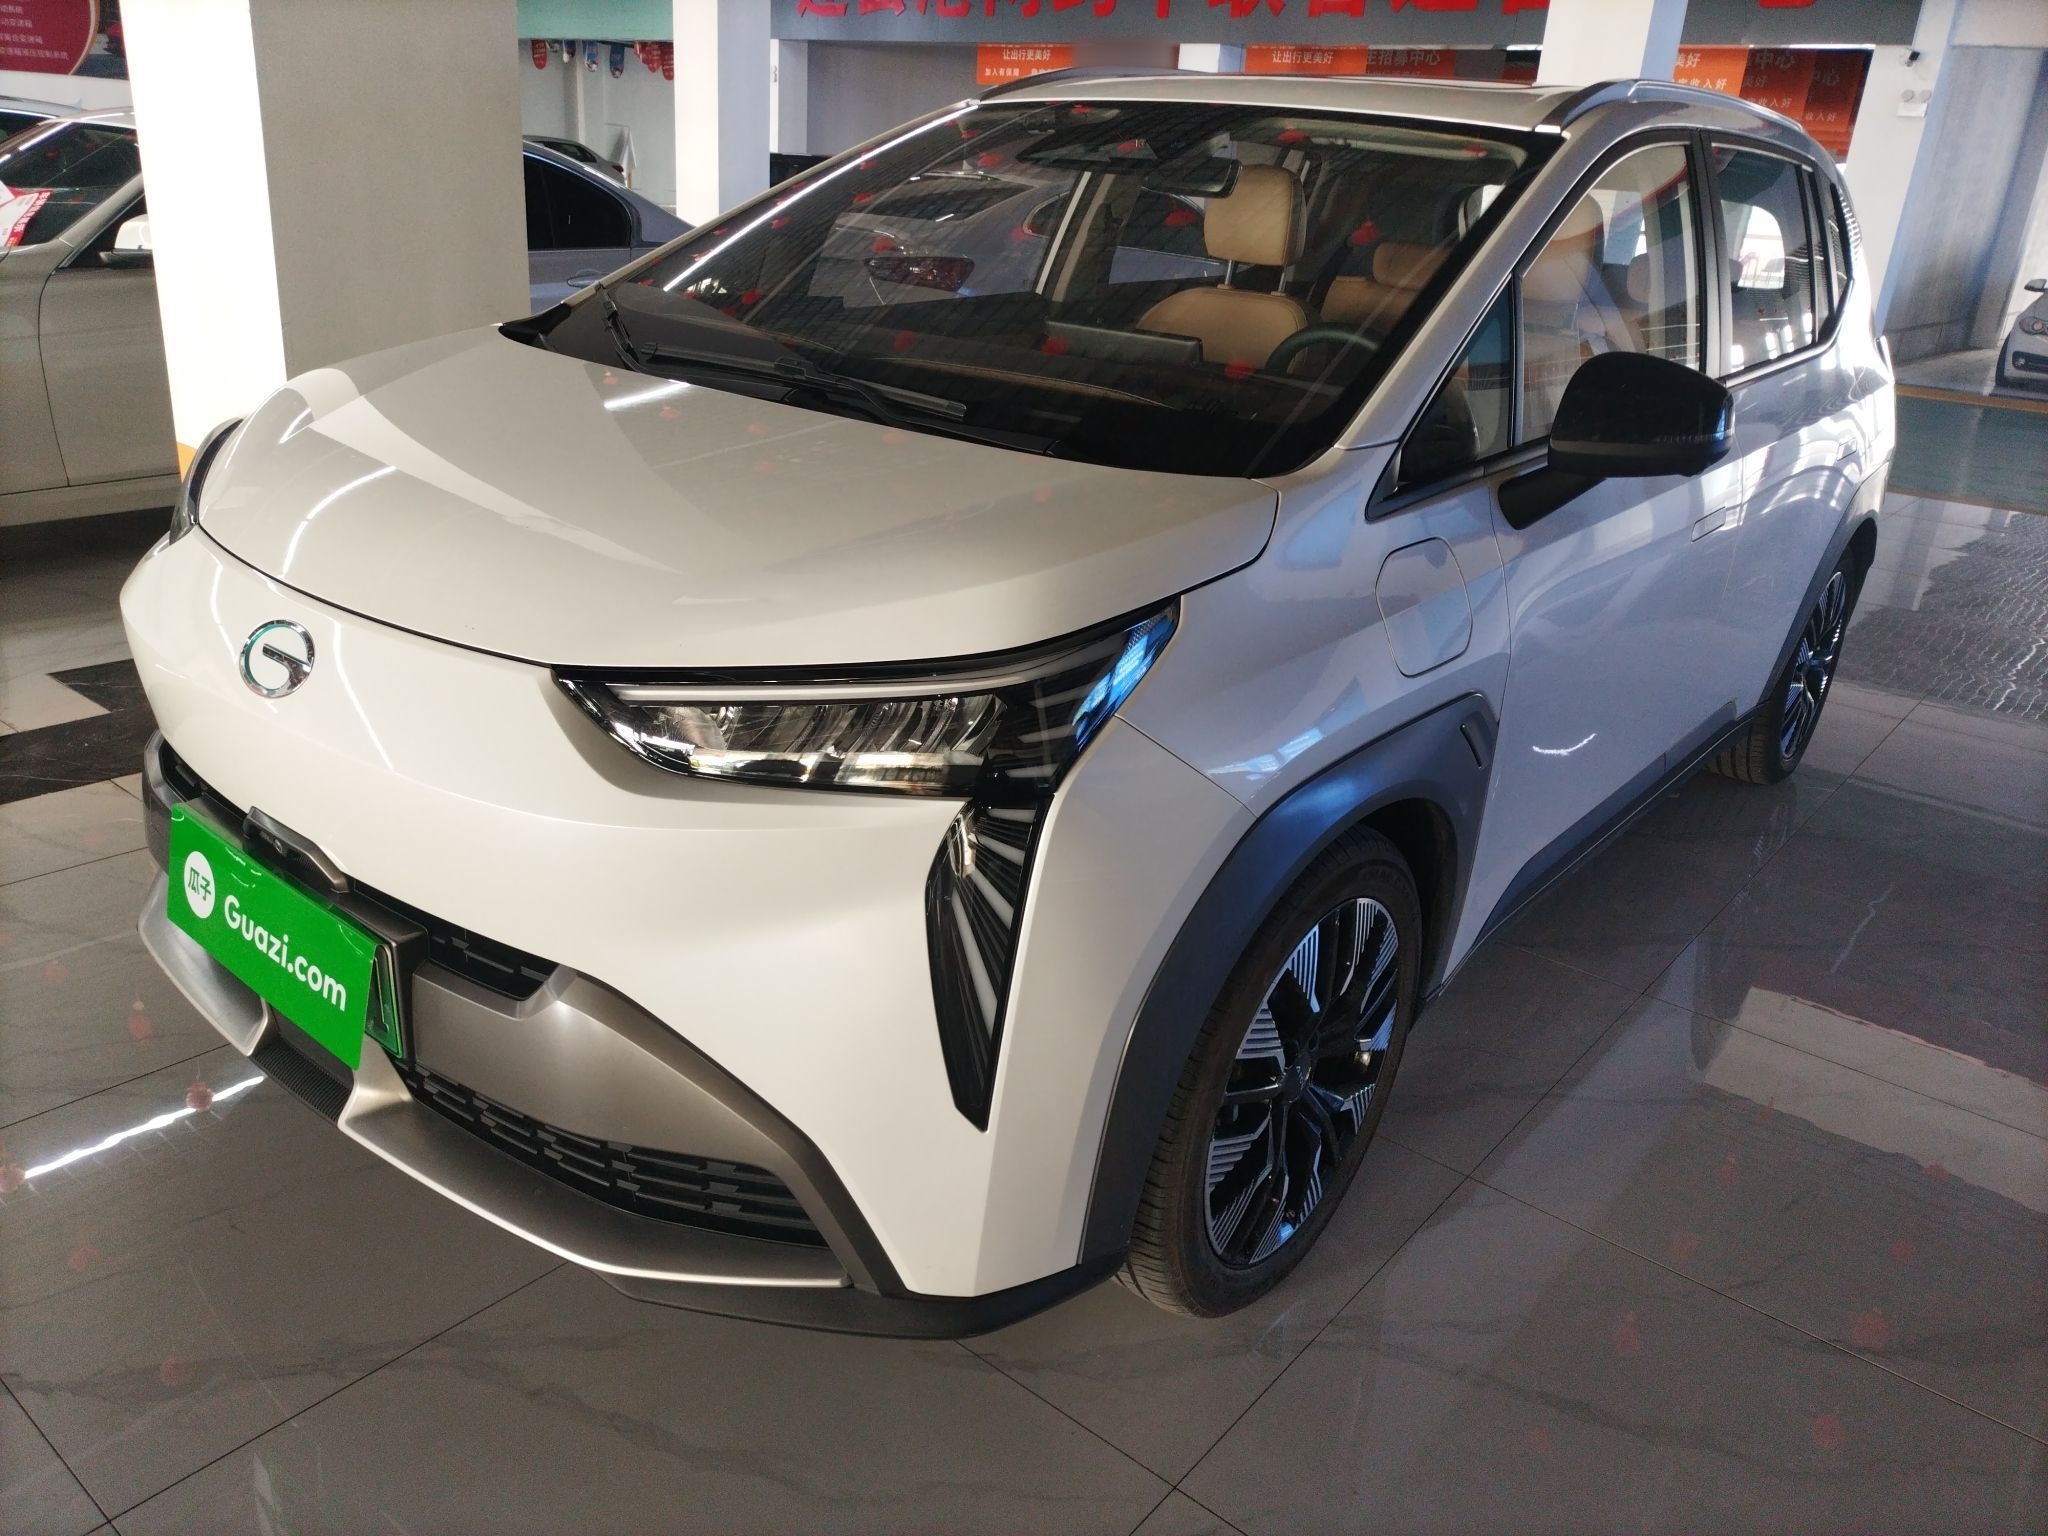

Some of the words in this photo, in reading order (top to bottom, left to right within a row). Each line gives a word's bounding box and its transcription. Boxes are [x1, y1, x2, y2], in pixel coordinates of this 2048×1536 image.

[1003, 48, 1051, 60] 让出行更美好
[1272, 51, 1334, 64] 让出行更美好
[984, 67, 1020, 77] 加入有保障
[1805, 111, 1837, 122] 收入好
[188, 866, 212, 901] 瓜子
[224, 894, 347, 1012] Guazi.com
